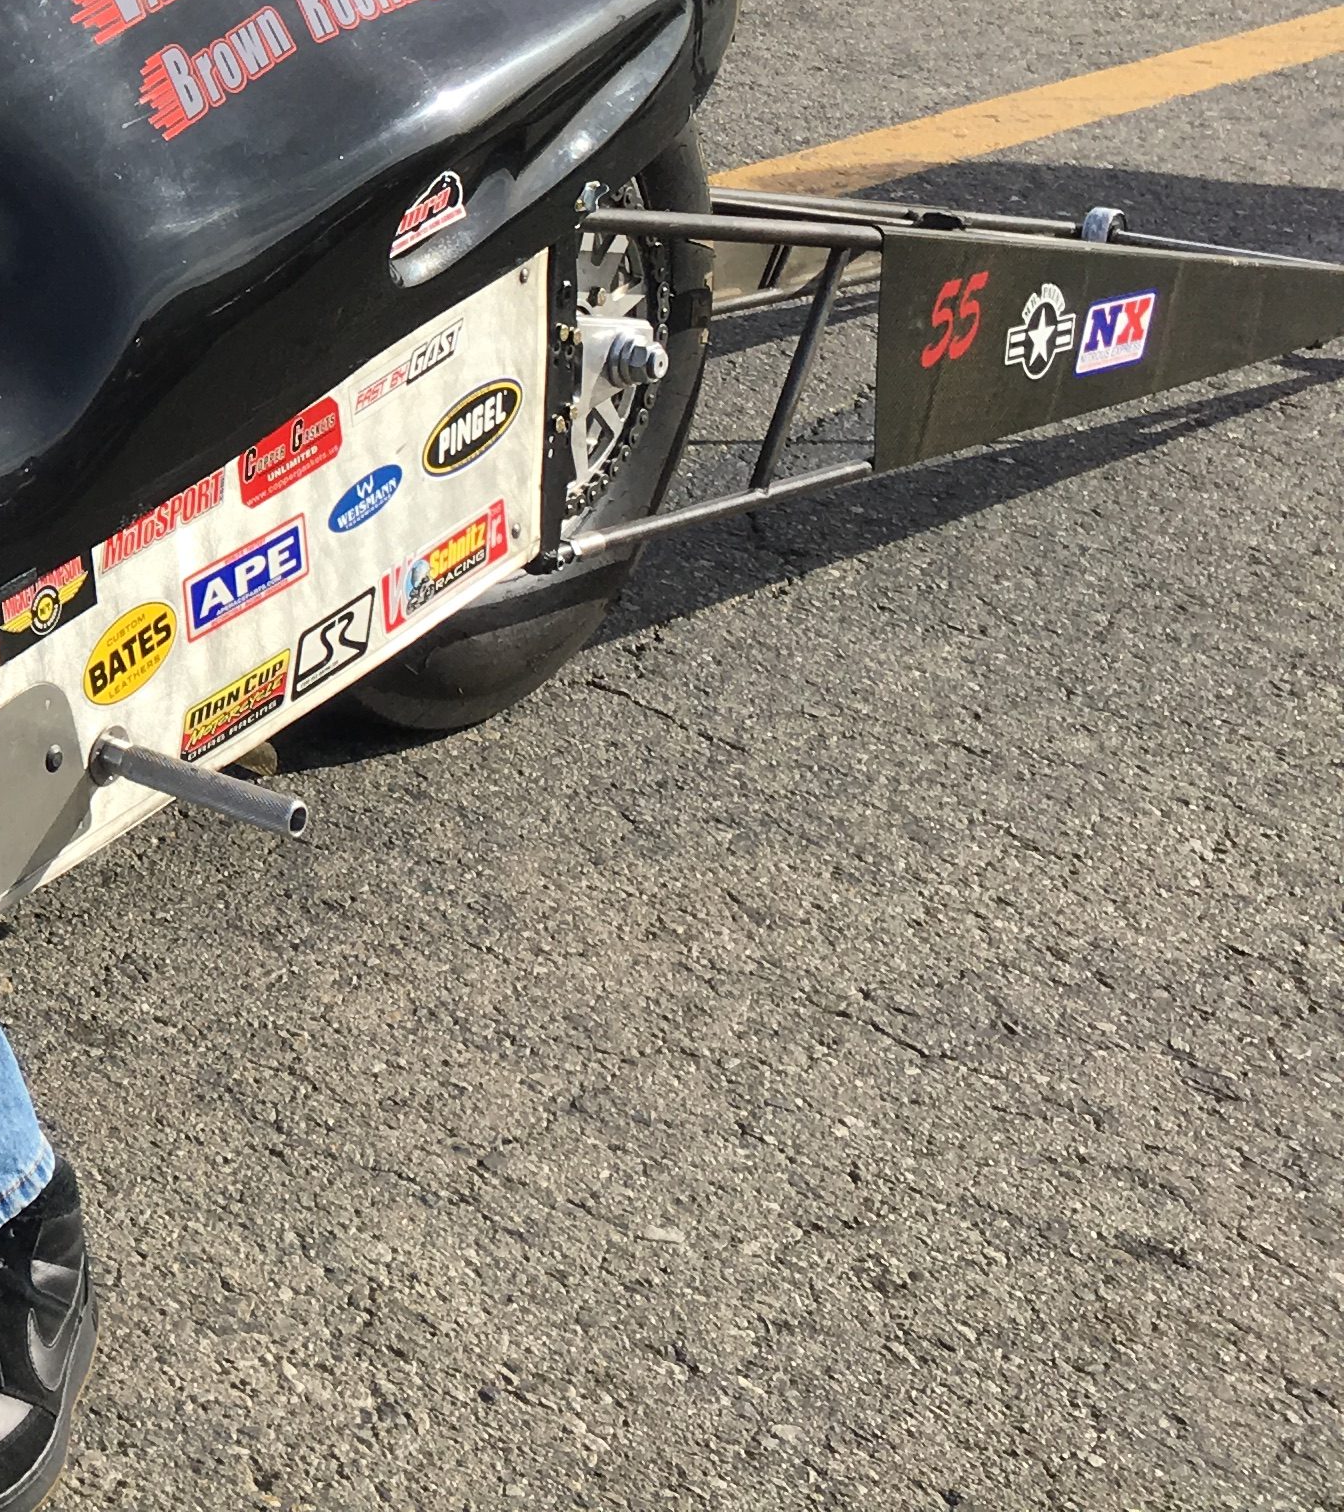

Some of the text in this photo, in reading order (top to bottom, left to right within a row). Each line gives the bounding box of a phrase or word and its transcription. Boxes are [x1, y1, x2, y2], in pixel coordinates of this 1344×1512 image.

[152, 5, 297, 128] Brown
[920, 270, 990, 369] 55
[1083, 296, 1152, 354] NX
[355, 323, 462, 412] FAST BY GAST
[438, 390, 507, 465] PINGEL
[267, 445, 318, 482] UNLIMITED
[336, 477, 398, 529] WEISMANN
[199, 535, 298, 620] APE
[429, 521, 487, 580] Schnitz
[435, 548, 486, 591] RACING
[88, 611, 172, 698] BATES
[106, 613, 146, 648] CUSTOM
[108, 654, 161, 700] LEATHERS
[187, 699, 278, 762] DRAG RACING
